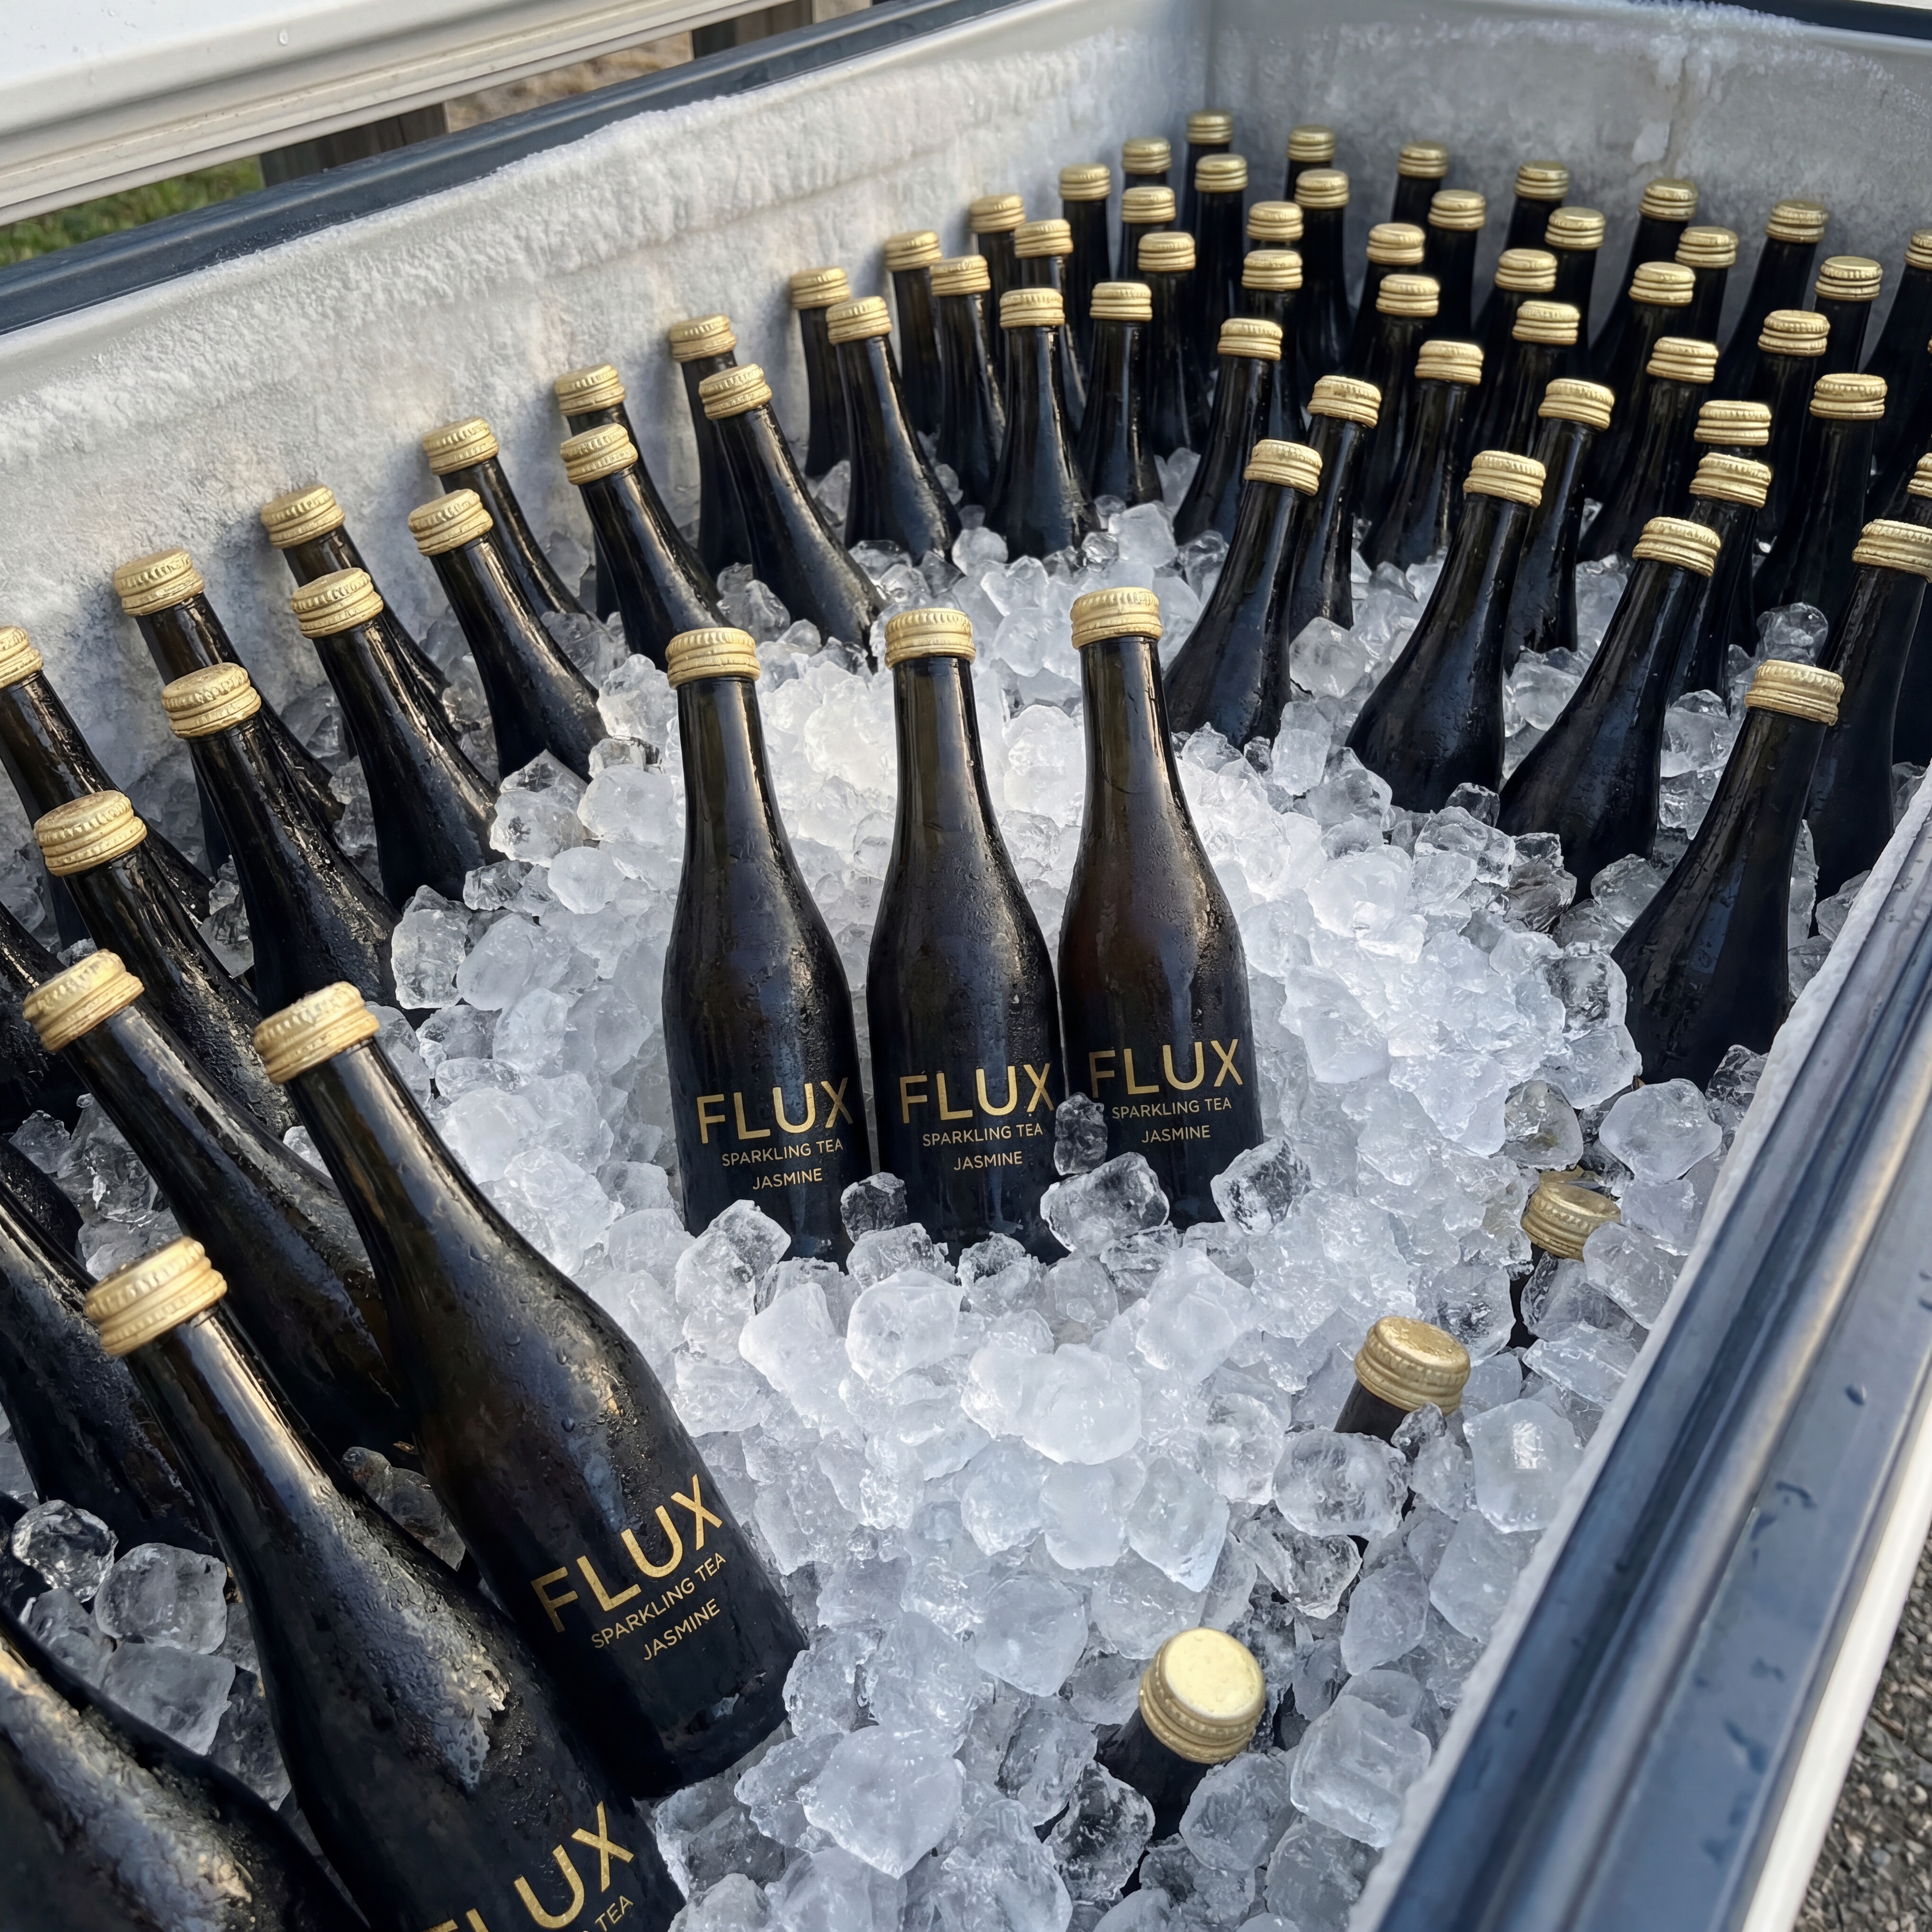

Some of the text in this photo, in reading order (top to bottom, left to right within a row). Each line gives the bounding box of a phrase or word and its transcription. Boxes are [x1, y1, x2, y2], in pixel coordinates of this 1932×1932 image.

[1089, 1039, 1243, 1098] FLUX
[697, 1077, 853, 1144] FLUX
[899, 1063, 1054, 1124] FLUX
[1112, 1097, 1232, 1119] SPARKLING TEA
[722, 1139, 843, 1166] SPARKLING TEA
[923, 1123, 1043, 1146] SPARKLING TEA
[1141, 1125, 1210, 1143] JASMINE
[753, 1167, 823, 1190] JASMINE
[954, 1151, 1023, 1170] JASMINE
[531, 1474, 723, 1632] FLUX
[591, 1552, 726, 1649] SPARKLING TEA
[643, 1599, 720, 1660] JASMINE
[423, 1801, 634, 1932] UX
[595, 1895, 633, 1932] TEA
